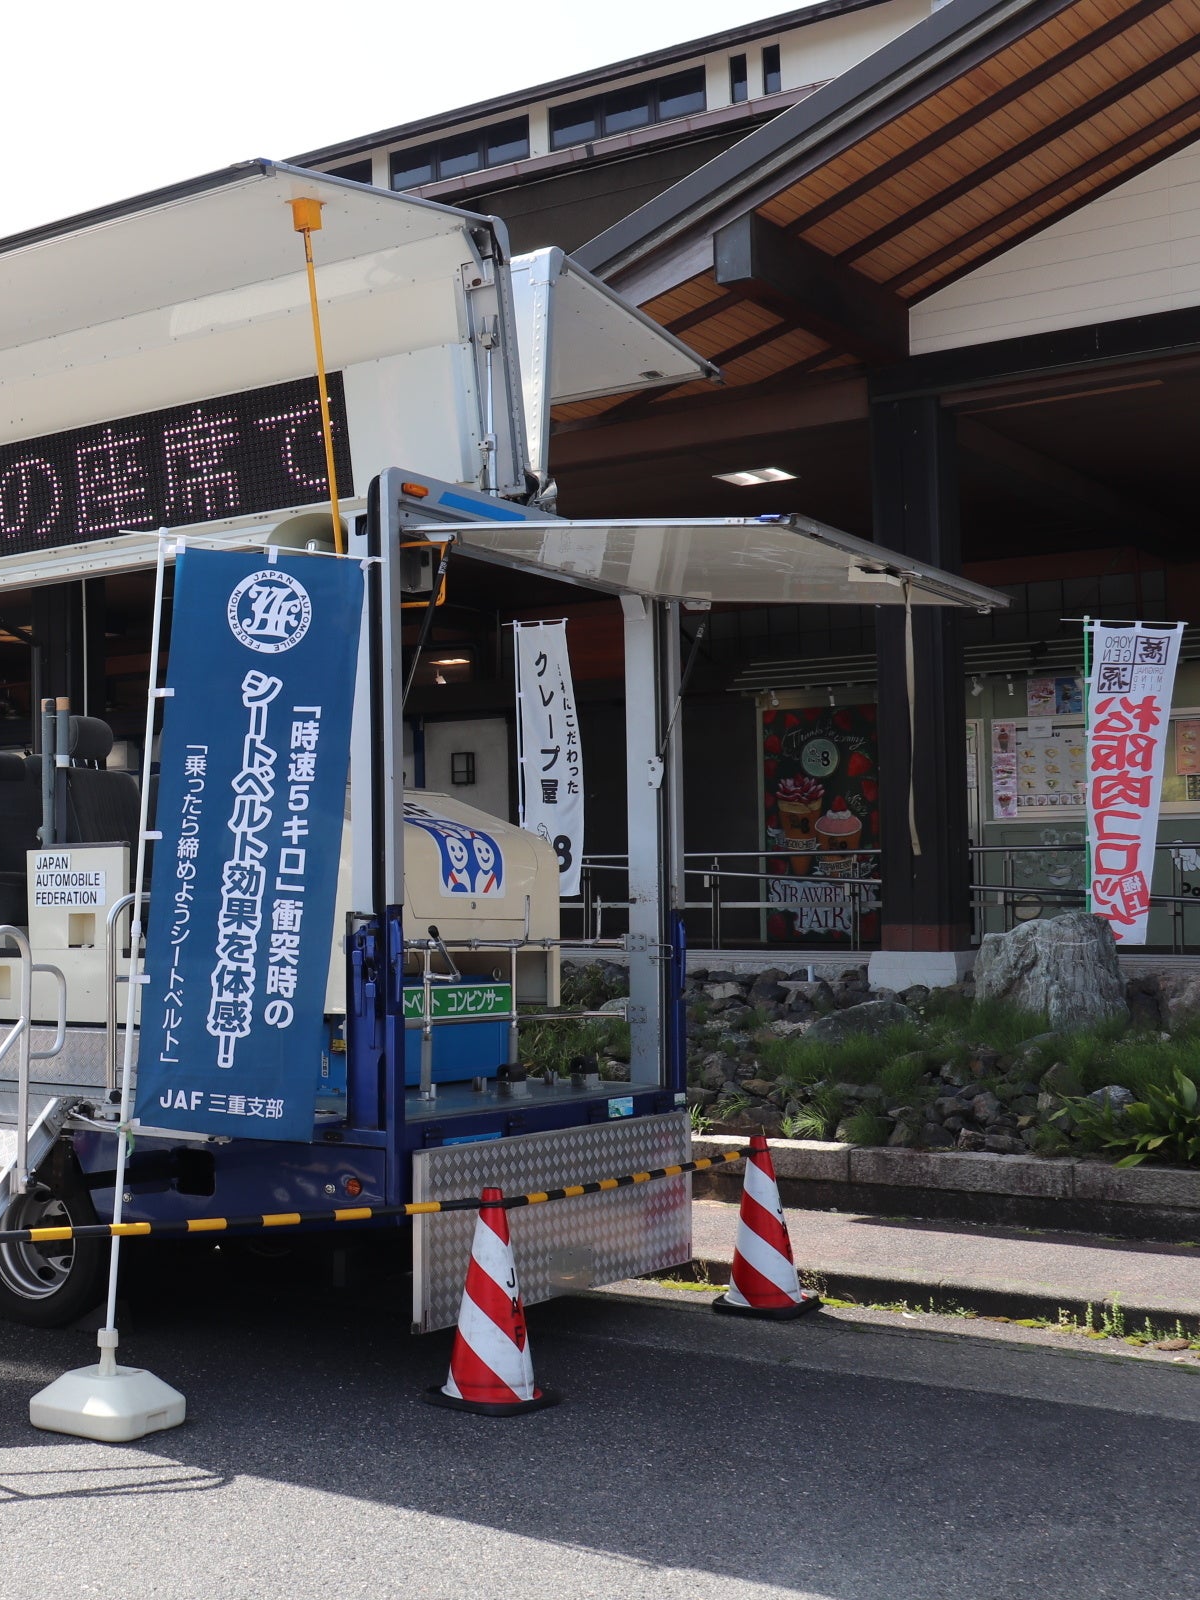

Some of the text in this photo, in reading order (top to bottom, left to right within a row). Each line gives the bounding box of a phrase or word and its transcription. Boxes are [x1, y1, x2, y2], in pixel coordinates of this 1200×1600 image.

[253, 571, 294, 585] JAPAN
[229, 589, 261, 650] FEDERATION
[273, 594, 311, 652] AUTOMOBILE
[534, 650, 560, 805] クレープ屋
[36, 855, 69, 870] JAPAN
[36, 873, 101, 888] AUTOMOBILE
[771, 879, 872, 903] STRAWBEY
[36, 890, 98, 906] FEDERATION
[160, 743, 209, 1063] 「乗ったら締めようシートベルト」
[798, 906, 851, 930] FAIR
[403, 988, 504, 1016] トベト コンビンサー
[160, 1088, 204, 1110] JAF
[208, 1093, 284, 1120] 三重支部
[506, 1267, 523, 1347] JAF
